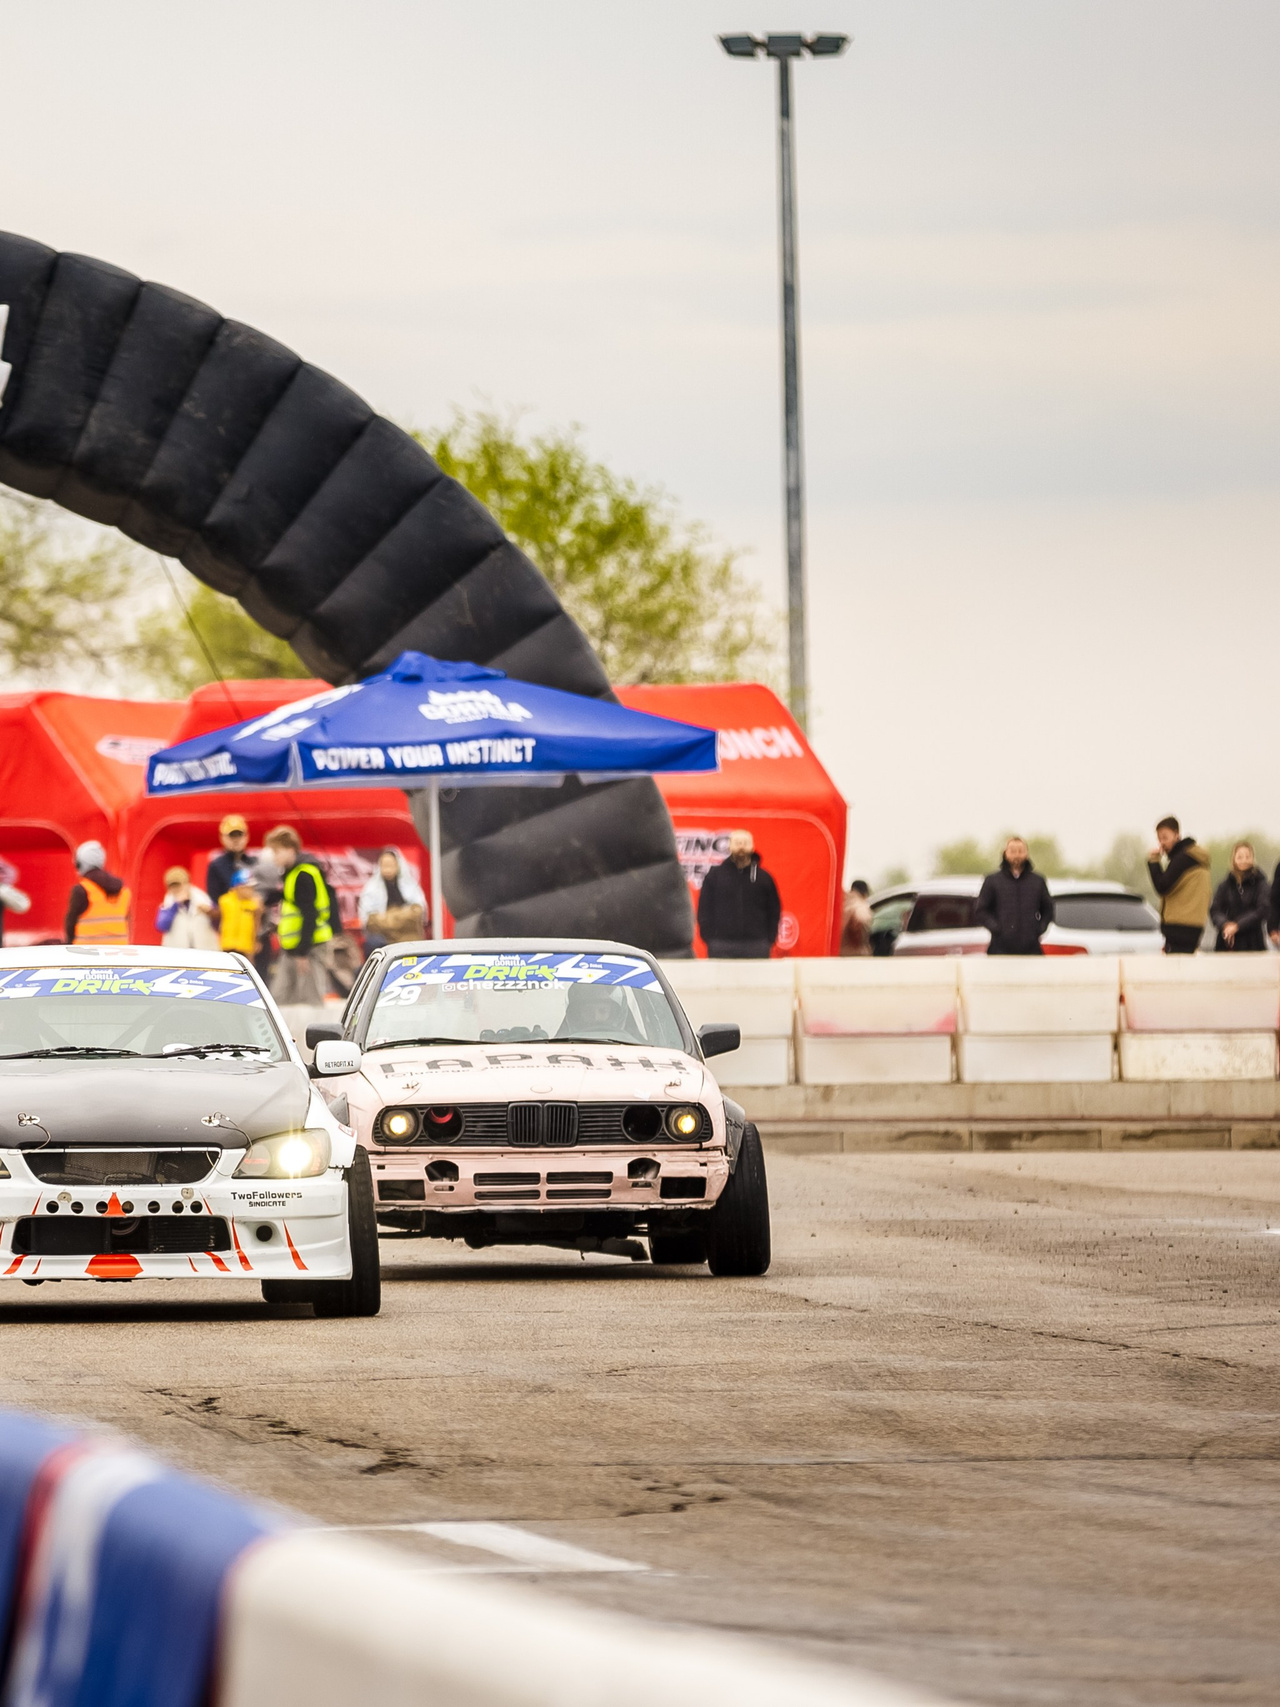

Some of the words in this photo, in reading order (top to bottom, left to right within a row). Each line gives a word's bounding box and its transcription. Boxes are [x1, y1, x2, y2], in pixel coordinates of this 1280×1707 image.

[312, 747, 385, 771] POWER
[387, 743, 444, 768] YOUR
[445, 737, 536, 765] INSTINCT
[494, 959, 526, 967] GORILLA
[85, 973, 120, 981] GORILLA
[456, 977, 566, 991] chezzznok
[376, 985, 422, 1009] 29
[324, 1060, 355, 1068] RETROFIT.KZ
[230, 1191, 303, 1200] TwoFollowers
[248, 1200, 287, 1208] SINDICATE
